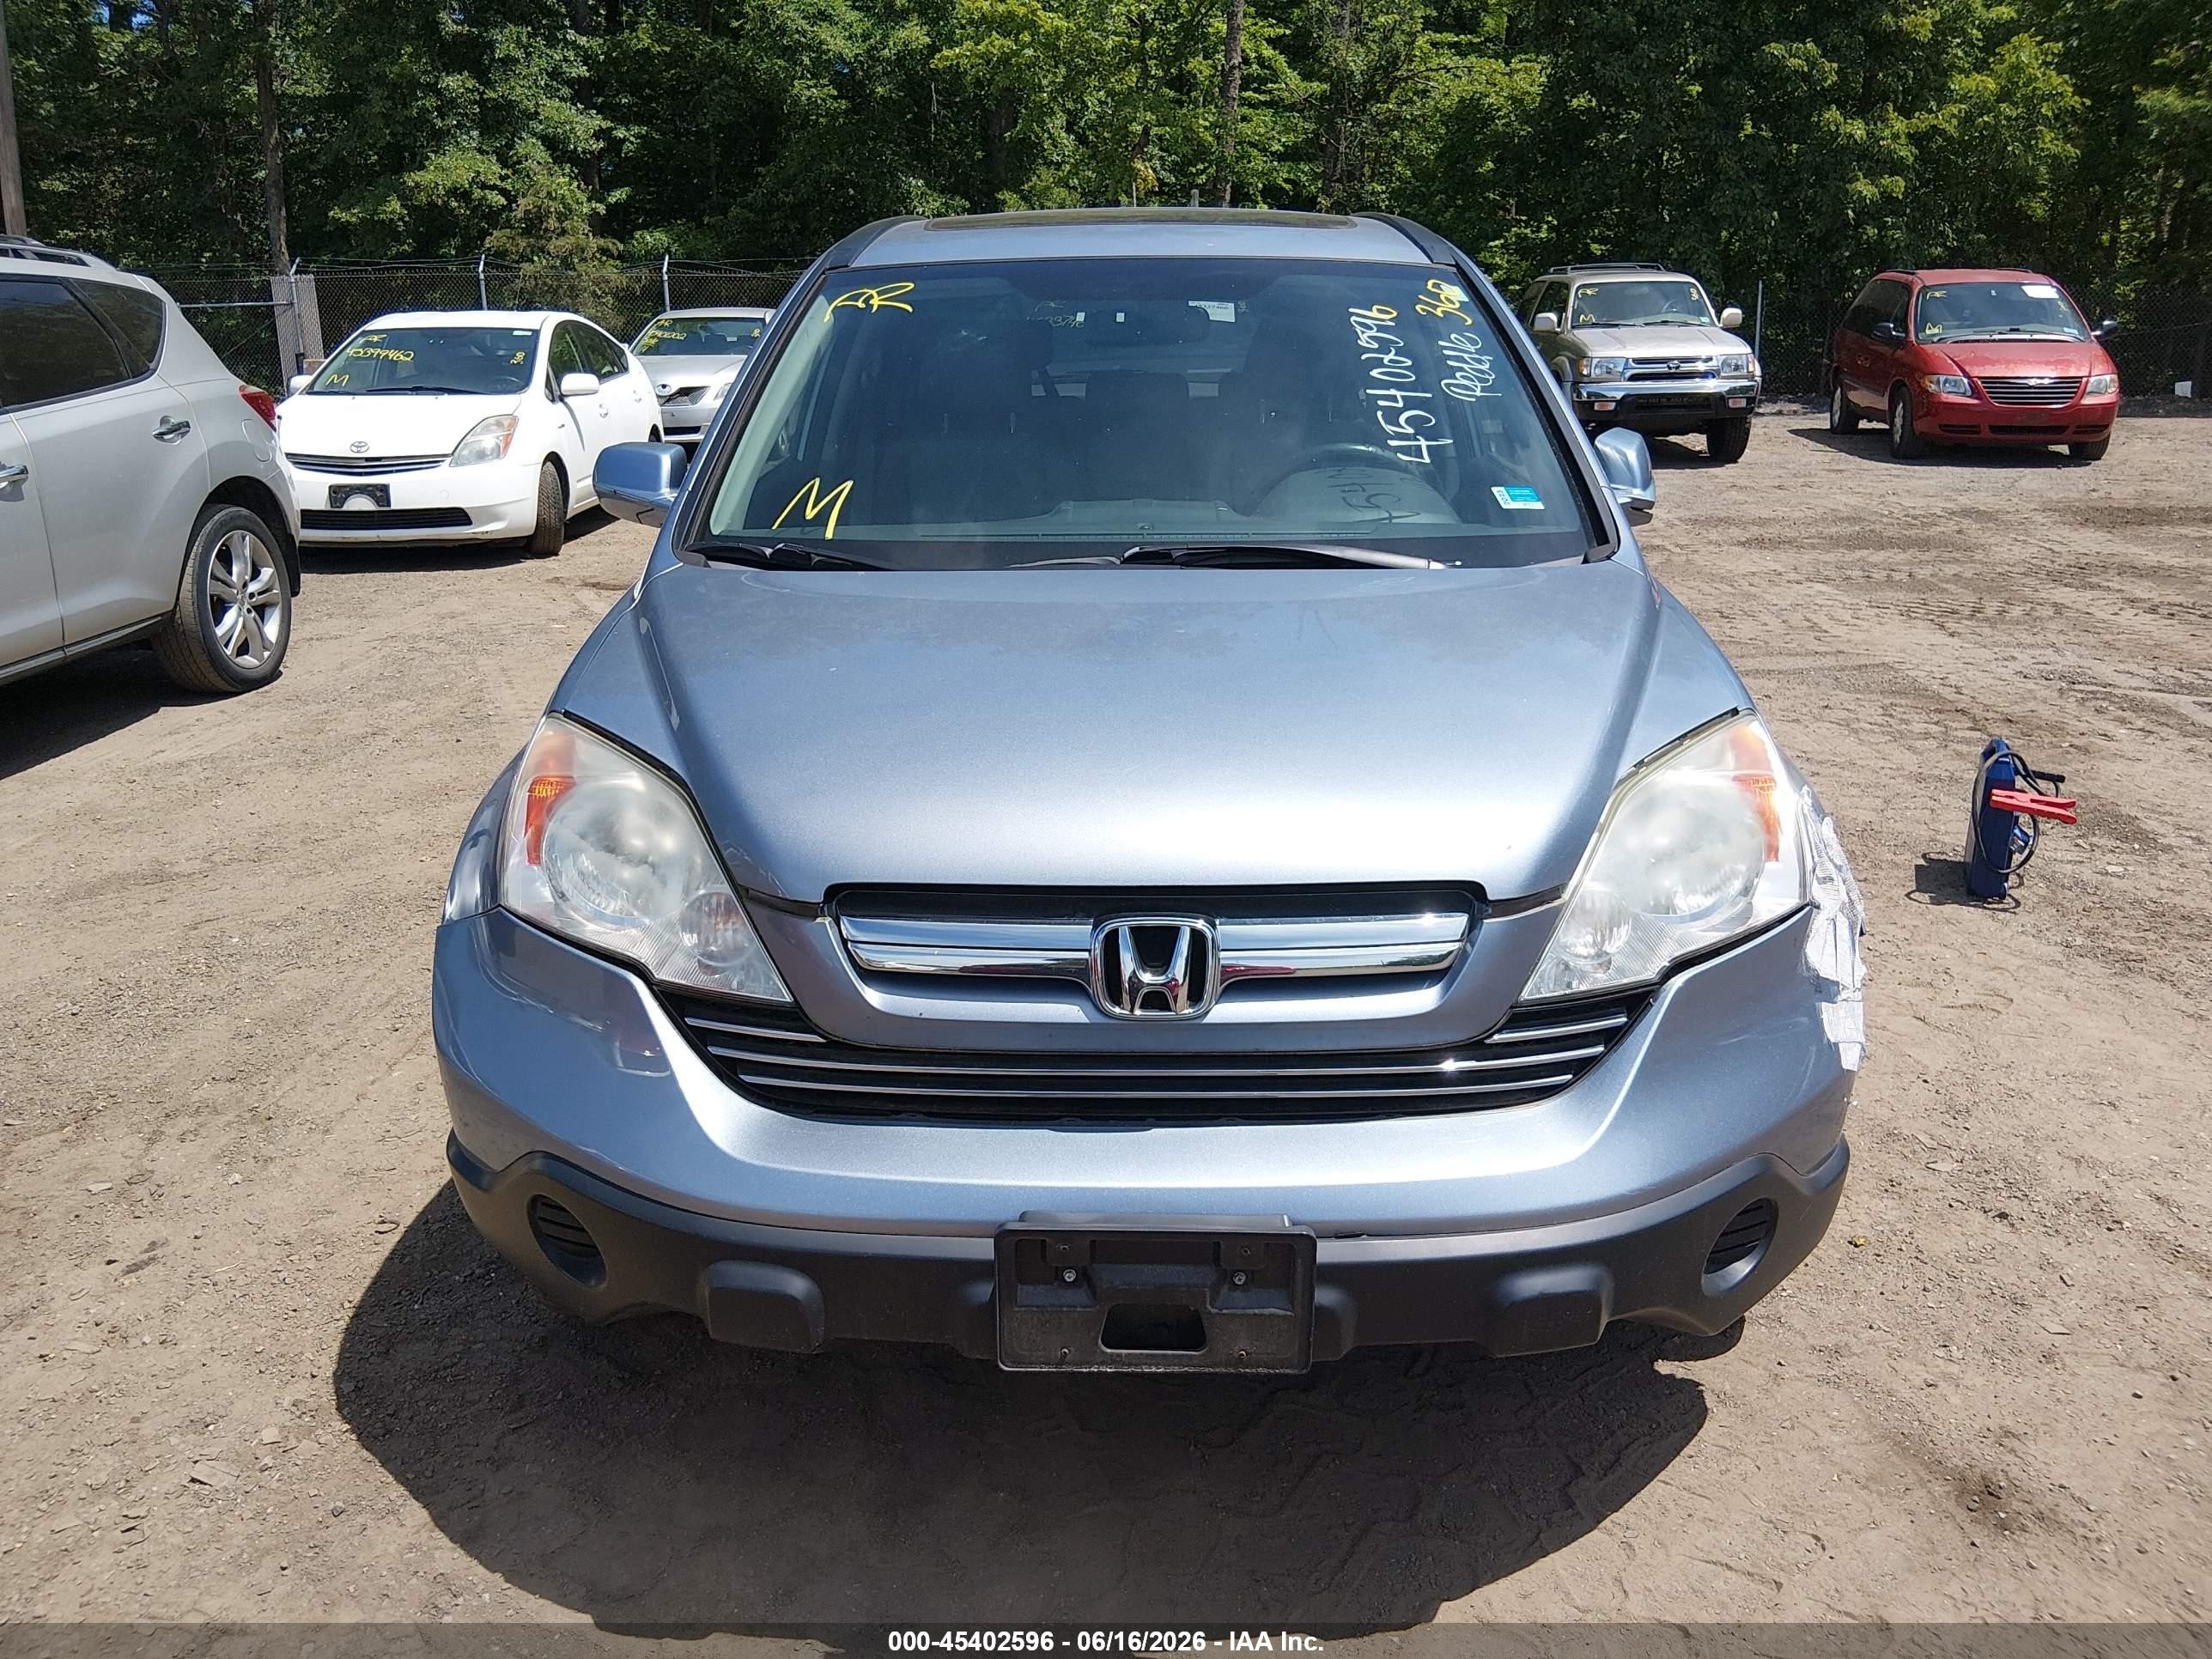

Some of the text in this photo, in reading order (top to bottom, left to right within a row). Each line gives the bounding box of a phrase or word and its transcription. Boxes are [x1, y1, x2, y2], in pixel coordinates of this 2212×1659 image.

[1414, 279, 1474, 325] 360
[346, 346, 415, 362] 45399462
[509, 351, 526, 365] 360
[325, 374, 349, 387] M
[1348, 304, 1454, 464] 45402596
[771, 477, 854, 541] M
